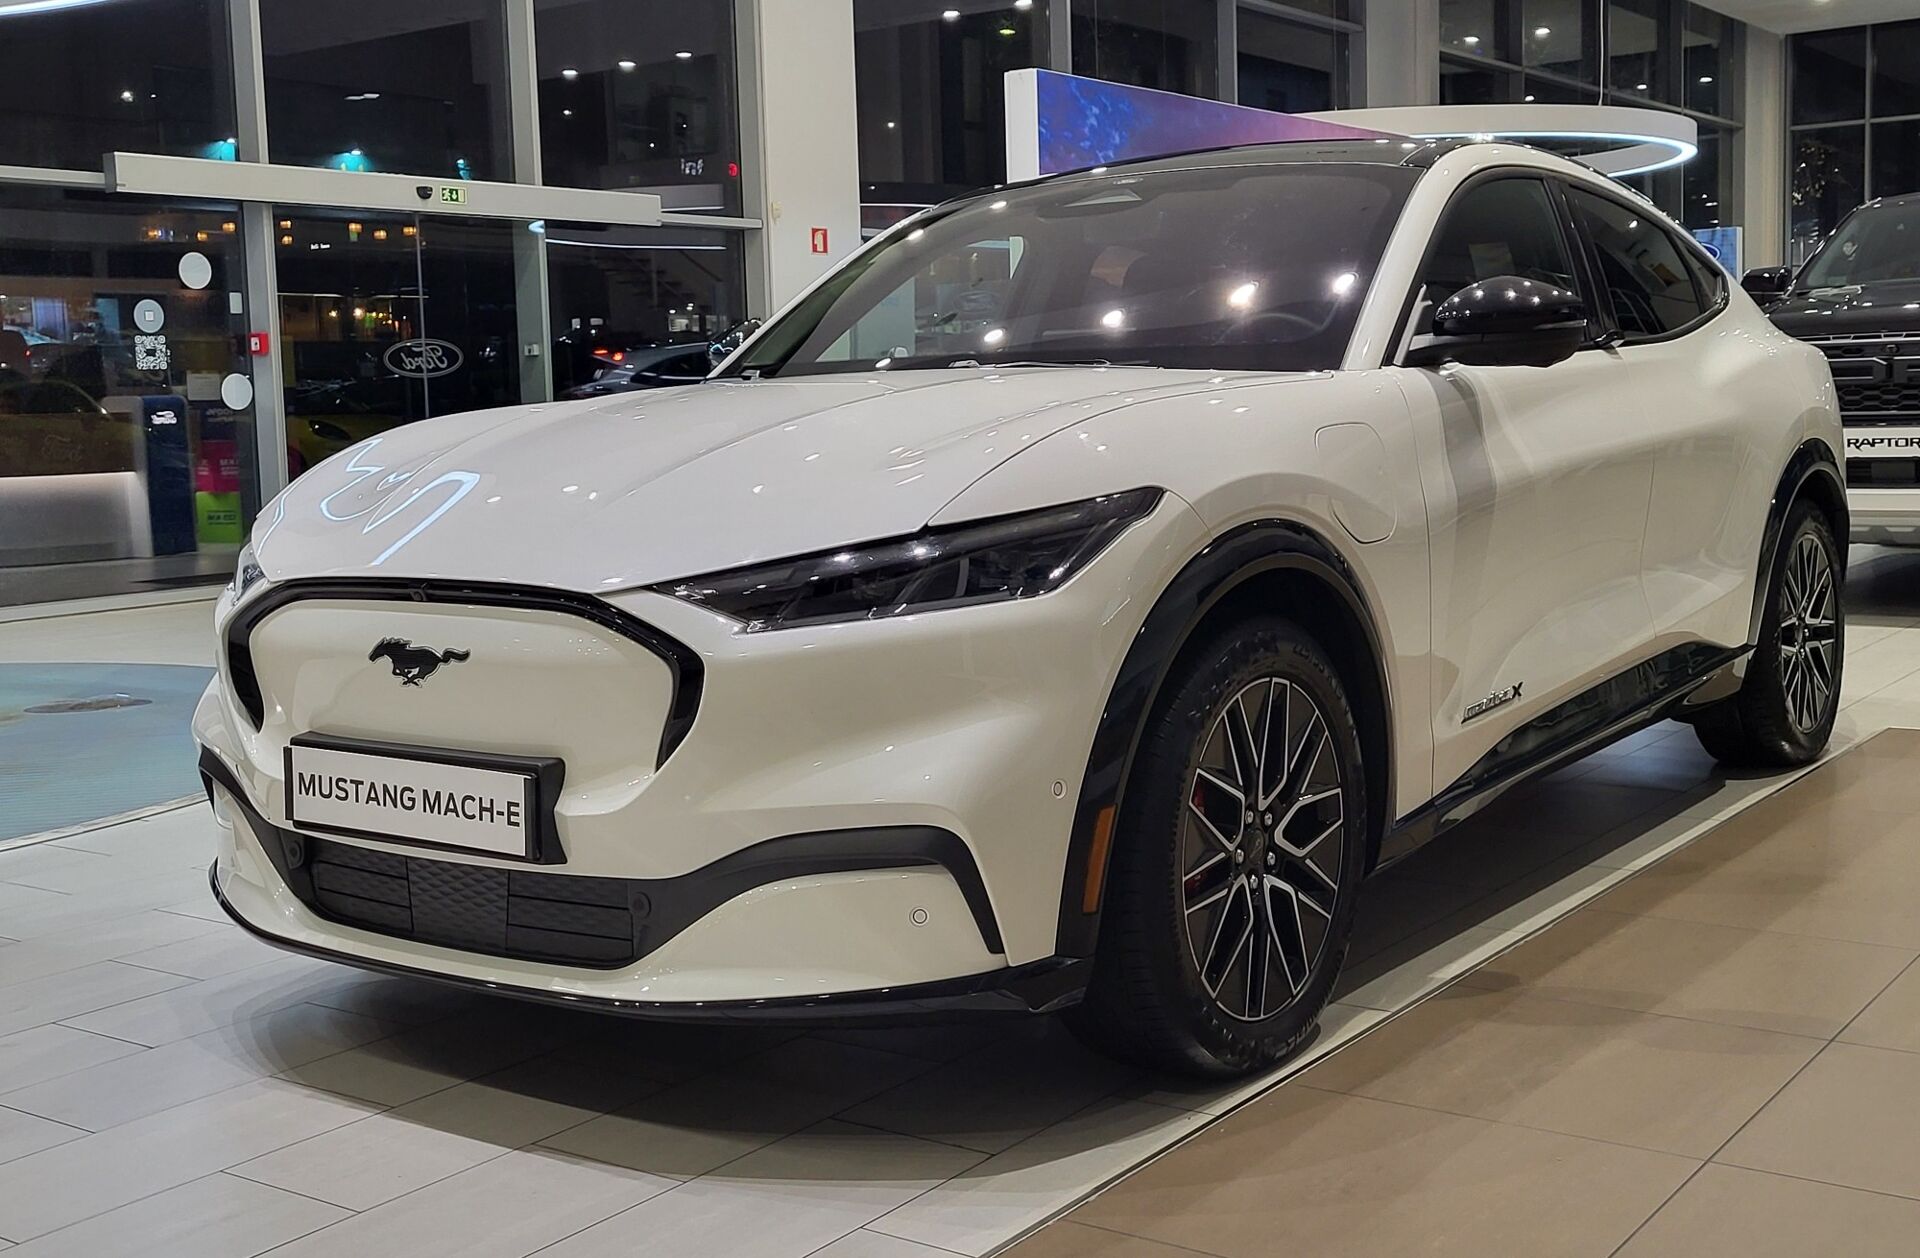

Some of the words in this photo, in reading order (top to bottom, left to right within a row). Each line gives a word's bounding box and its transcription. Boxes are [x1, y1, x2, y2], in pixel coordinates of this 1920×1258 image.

[1846, 437, 1920, 451] RAPTOR
[297, 772, 417, 812] MUSTANG
[422, 788, 521, 828] MACH-E
